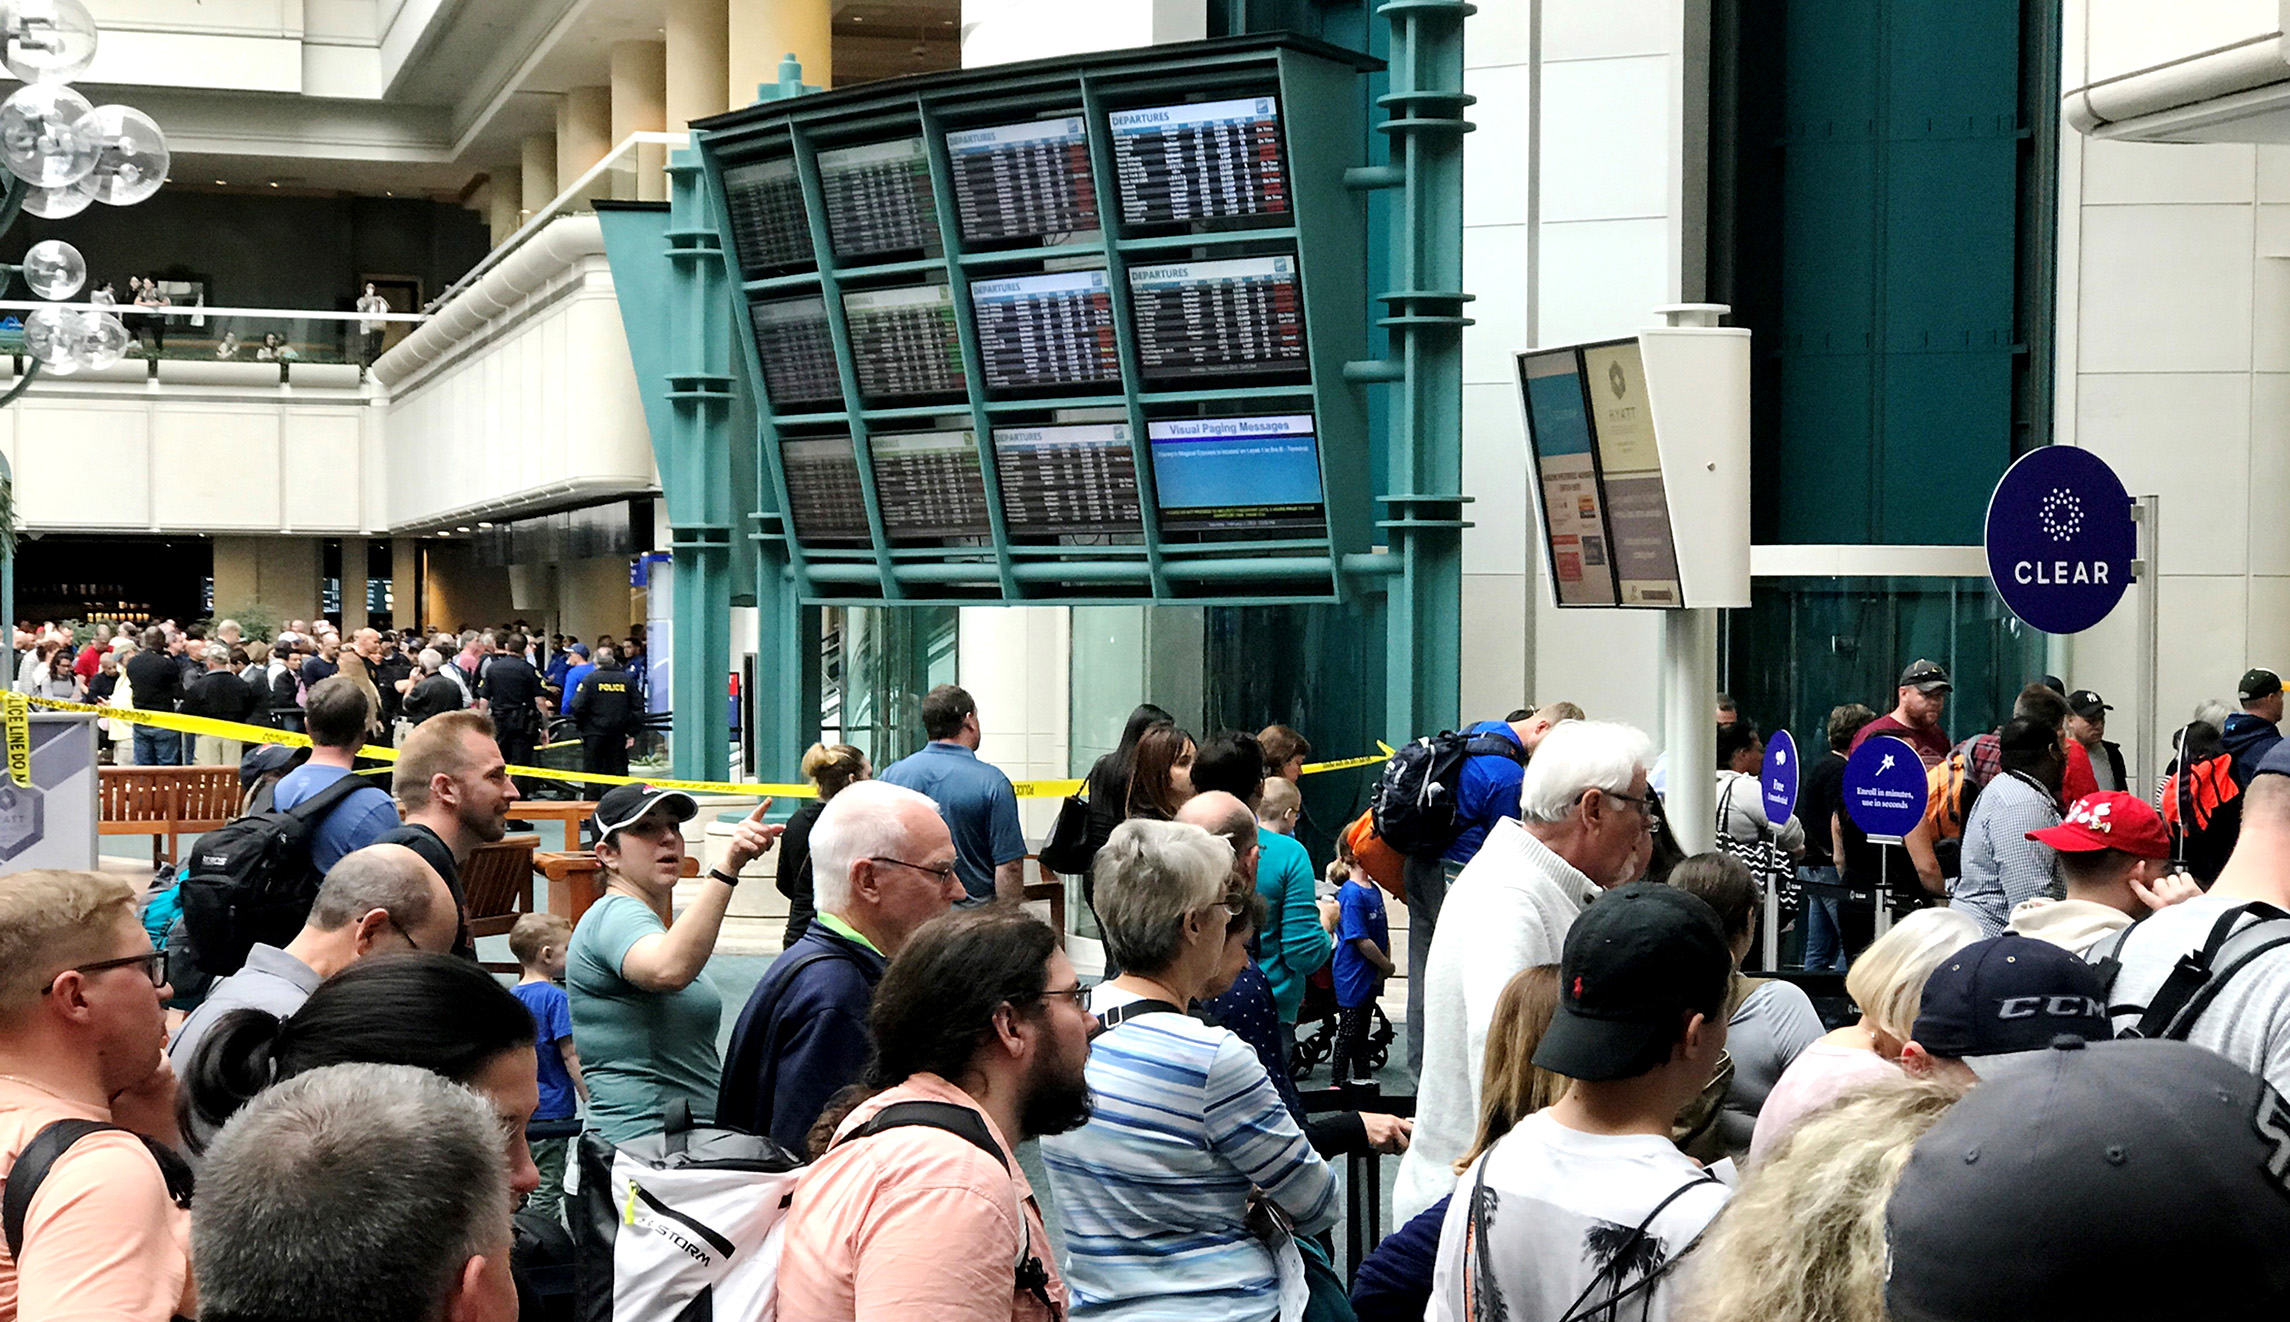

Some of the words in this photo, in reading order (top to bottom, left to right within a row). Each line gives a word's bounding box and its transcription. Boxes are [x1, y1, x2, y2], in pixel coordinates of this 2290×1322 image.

[1112, 112, 1170, 126] DEPARTURES
[949, 132, 997, 145] DEPARTURES
[1131, 268, 1188, 281] DEPARTURES
[973, 282, 1021, 295] DEPARTURES
[1169, 424, 1200, 435] Visual
[1202, 423, 1237, 435] Paging
[1239, 421, 1290, 433] Messages
[995, 432, 1043, 442] DEPARTURES
[2014, 561, 2109, 585] CLEAR
[598, 683, 626, 692] POLICE
[9, 726, 26, 750] LINE
[11, 753, 26, 770] DO
[1856, 786, 1877, 796] Enroll
[1877, 787, 1885, 796] in
[1885, 789, 1914, 800] minutes,
[1874, 798, 1881, 807] in
[1882, 800, 1909, 809] seconds
[1998, 996, 2106, 1019] CCM
[655, 1224, 711, 1268] STORM
